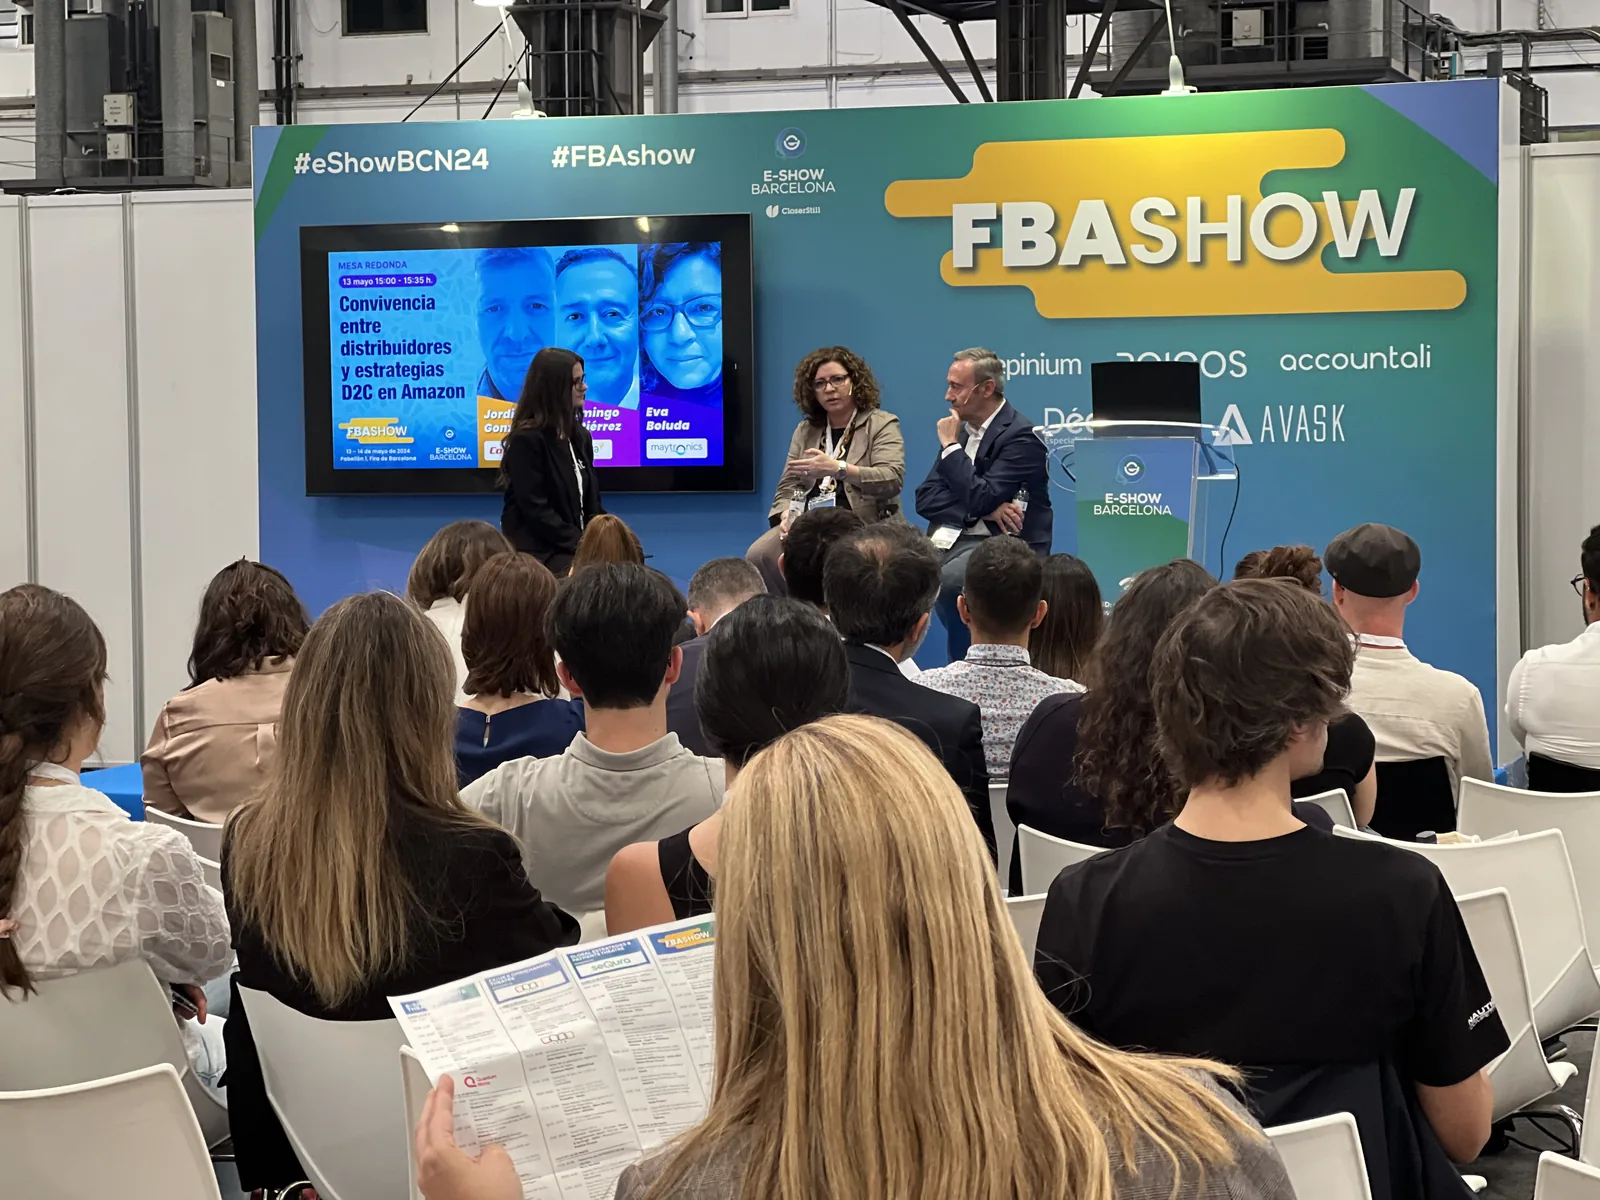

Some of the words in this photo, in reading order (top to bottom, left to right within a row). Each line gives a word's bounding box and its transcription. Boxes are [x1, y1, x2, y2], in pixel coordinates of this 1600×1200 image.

[294, 148, 489, 174] #eShowBCN24
[552, 144, 695, 168] #FBAshow
[763, 168, 825, 182] E-SHOW
[751, 181, 836, 195] BARCELONA
[781, 206, 821, 215] CloserStill
[952, 187, 1417, 268] FBASHOW
[338, 262, 363, 270] MESA
[365, 261, 408, 269] REDONDA
[342, 278, 352, 286] 13
[353, 279, 374, 287] mayo
[375, 277, 397, 285] 15:00
[403, 276, 425, 285] 15:35
[425, 276, 433, 284] h.
[339, 294, 436, 312] Convivencia
[340, 318, 382, 335] entre
[340, 339, 452, 356] distribuidores
[1280, 343, 1431, 371] accountali
[341, 365, 350, 381] y
[355, 361, 444, 381] estrategias
[342, 384, 373, 400] D2C
[377, 386, 397, 400] en
[401, 384, 465, 400] Amazon
[484, 408, 515, 419] Jordi
[646, 407, 669, 417] Eva
[646, 420, 690, 431] Boluda
[1260, 404, 1345, 443] AVASK
[347, 426, 408, 437] FBASHOW
[651, 441, 703, 455] maytronics
[1105, 493, 1162, 504] E-SHOW
[1093, 505, 1172, 515] BARCELONA
[664, 931, 710, 947] FBASHOW
